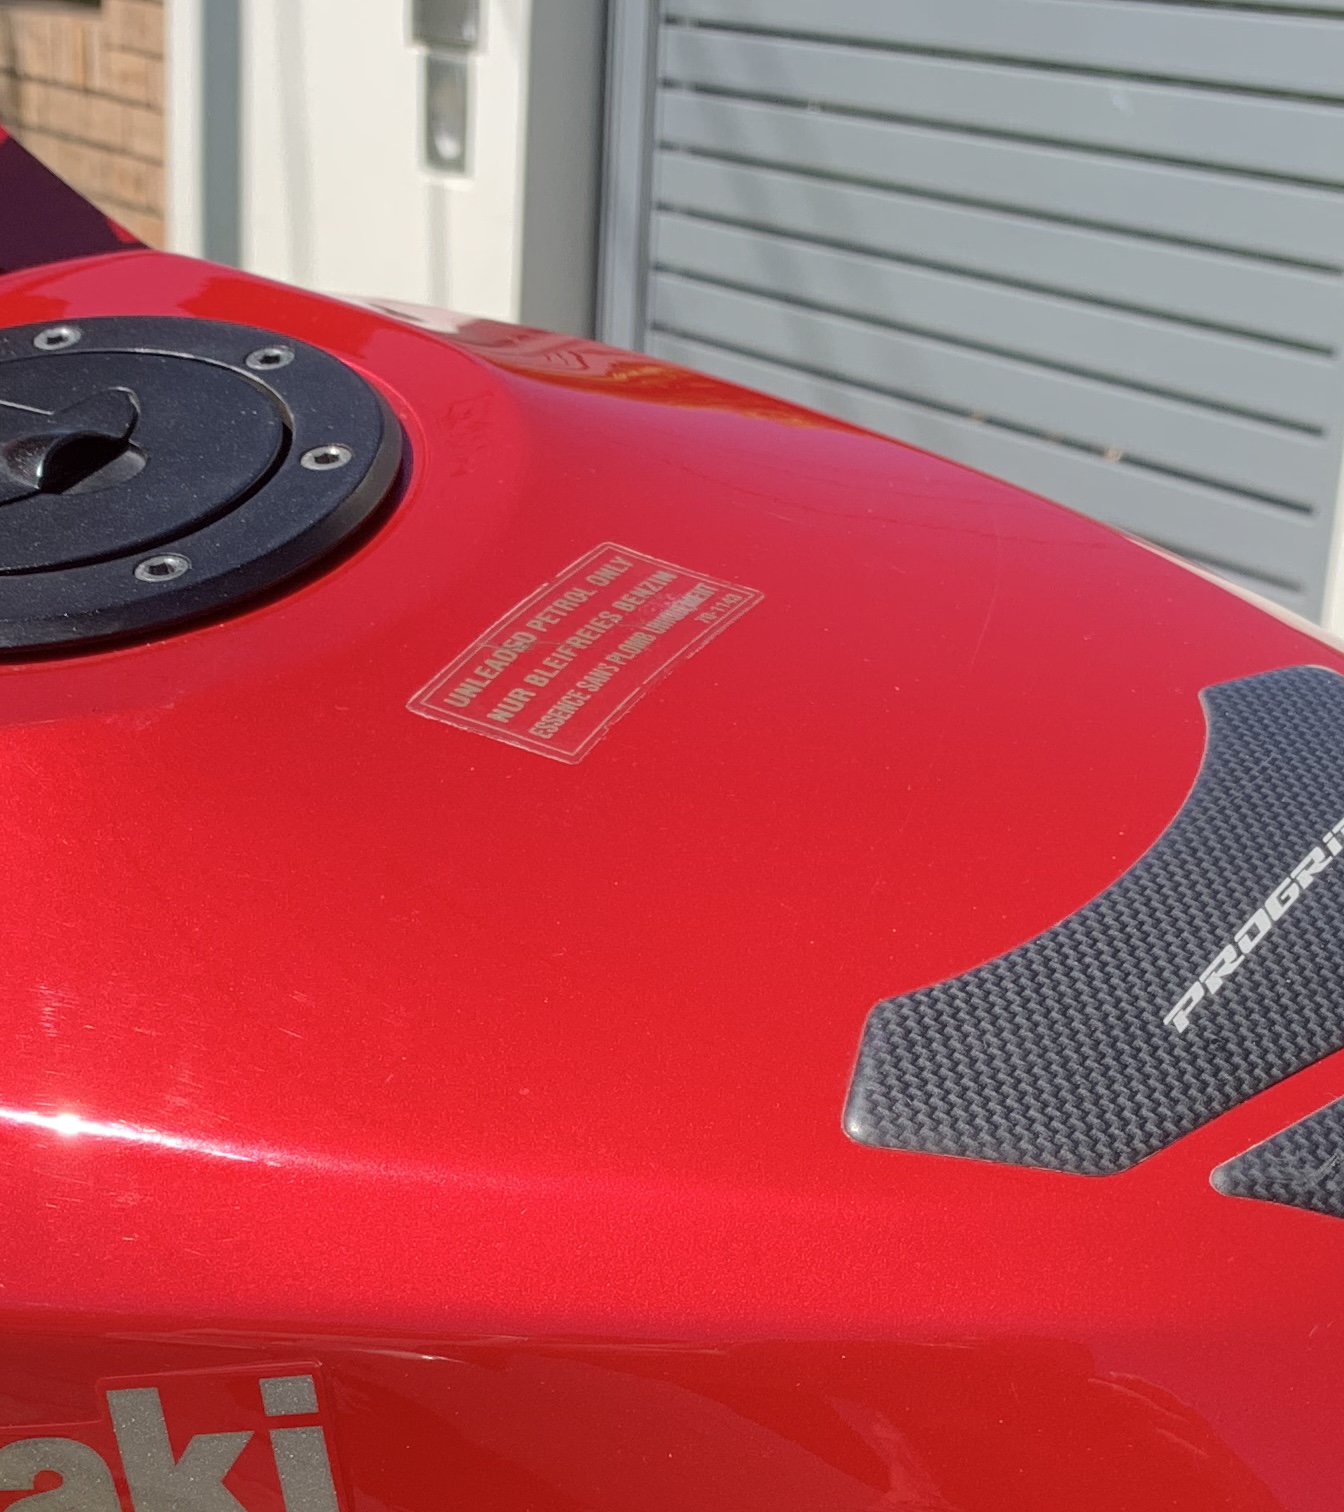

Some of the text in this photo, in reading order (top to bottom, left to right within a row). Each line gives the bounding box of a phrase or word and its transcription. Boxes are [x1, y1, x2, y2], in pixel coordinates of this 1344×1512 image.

[443, 556, 633, 707] UNLEADED PETROL ONLY
[486, 570, 677, 723] NUR BLEIFREIES BENZIN
[528, 689, 591, 739] ESSENCE
[576, 663, 620, 692] SANS
[605, 632, 656, 665] PLOMB
